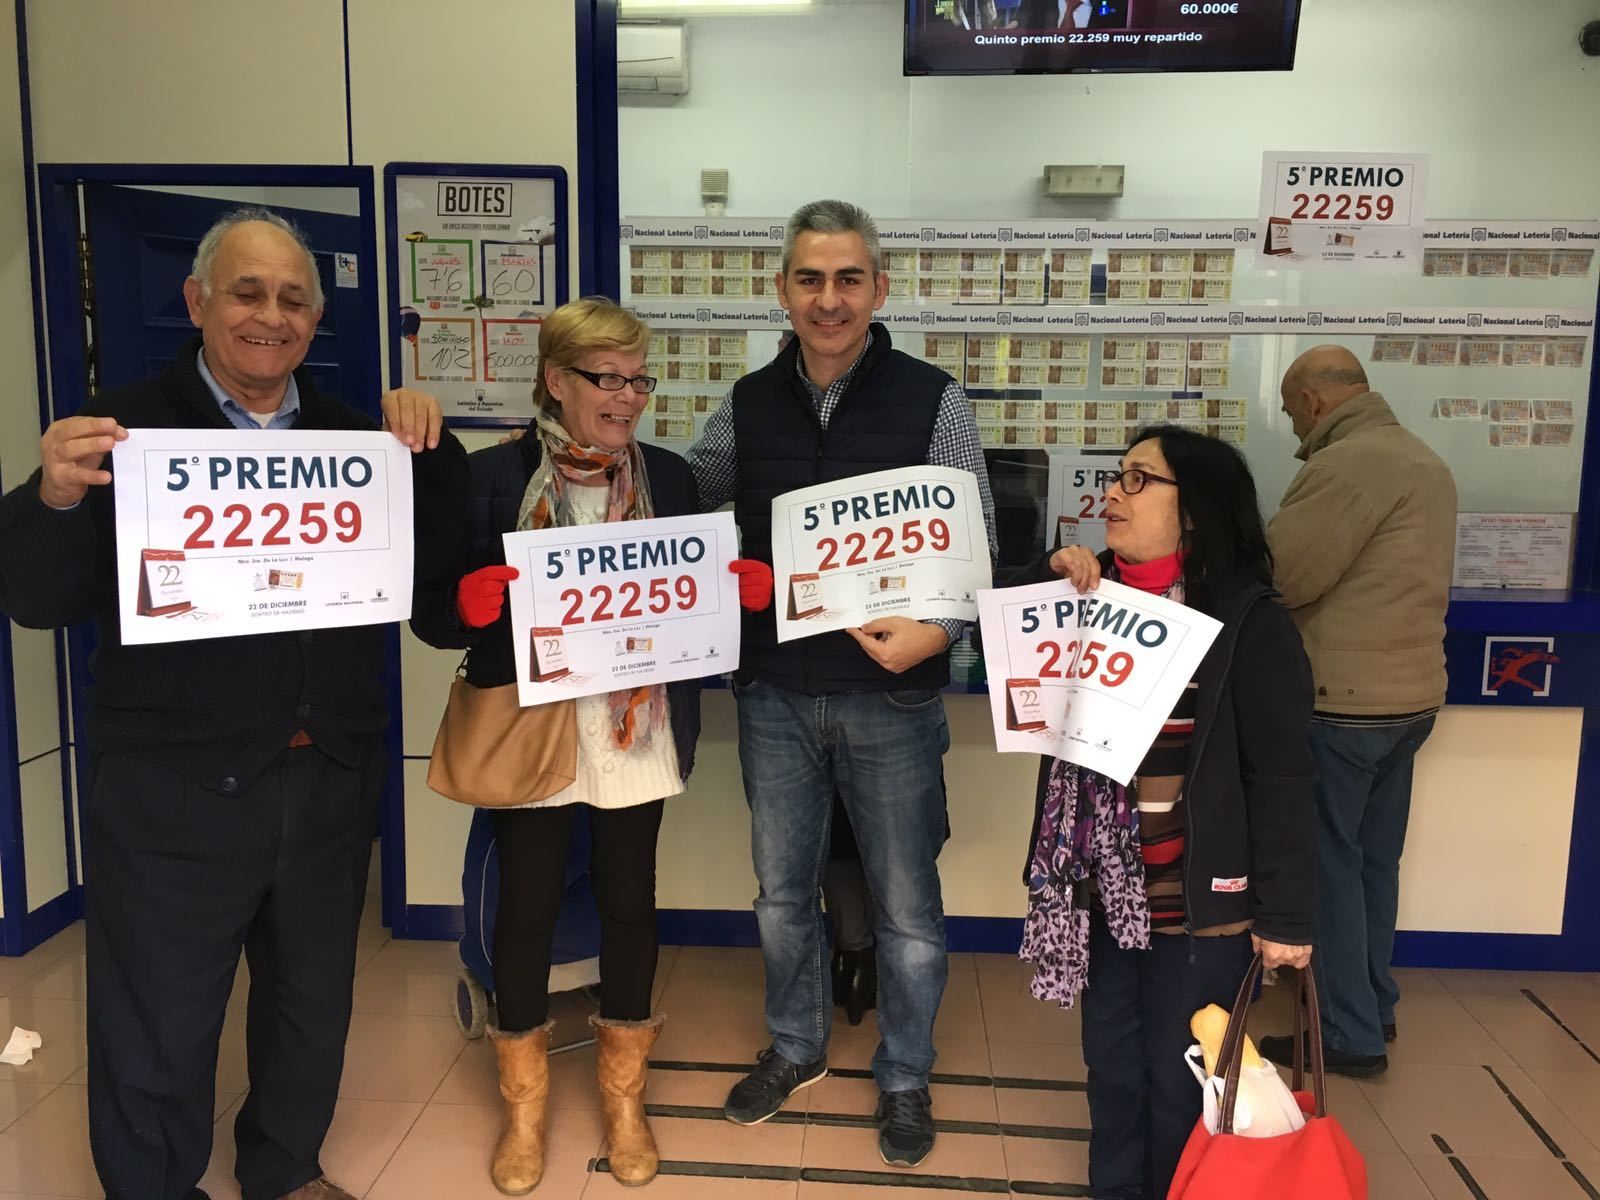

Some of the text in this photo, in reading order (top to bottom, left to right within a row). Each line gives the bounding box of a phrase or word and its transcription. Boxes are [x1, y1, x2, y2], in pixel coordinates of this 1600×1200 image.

[1180, 3, 1239, 15] 60.000€
[974, 31, 1203, 46] Quinto premio 22.259 muy repartido
[1309, 167, 1404, 187] PREMIO
[445, 185, 505, 213] BOTES
[1291, 193, 1394, 221] 22259
[635, 229, 665, 237] Nacional
[709, 229, 740, 237] Nacional
[936, 231, 968, 239] Nacional
[1014, 231, 1045, 239] Nacional
[1091, 231, 1123, 240] Nacional
[1170, 231, 1202, 239] Nacional
[1276, 226, 1288, 237] 22
[1423, 231, 1440, 239] ional
[1487, 231, 1520, 239] Nacional
[492, 269, 535, 296] 60
[636, 311, 667, 320] Nacional
[712, 312, 742, 321] Nacional
[936, 314, 967, 323] Nacional
[1013, 315, 1044, 324] Nacional
[1090, 316, 1122, 324] Nacional
[1244, 315, 1277, 323] Nacional
[1323, 316, 1355, 324] Nacional
[1403, 316, 1435, 324] Nacional
[1561, 319, 1593, 327] Nacional
[166, 455, 373, 492] 5º PREMIO
[803, 485, 956, 531] 5º PREMIO
[183, 500, 363, 550] 22259
[1065, 525, 1077, 536] 22
[816, 518, 950, 571] 22259
[546, 537, 706, 579] 5º PREMIO
[157, 565, 183, 587] 22
[800, 583, 818, 599] 22
[270, 600, 307, 608] DICIEMBRE
[560, 575, 698, 626] 22259
[881, 597, 911, 606] DICIEMBRE
[1021, 603, 1048, 633] 5º
[543, 640, 562, 658] 22
[628, 661, 656, 669] DICIEMBRE
[1019, 690, 1040, 707] 22
